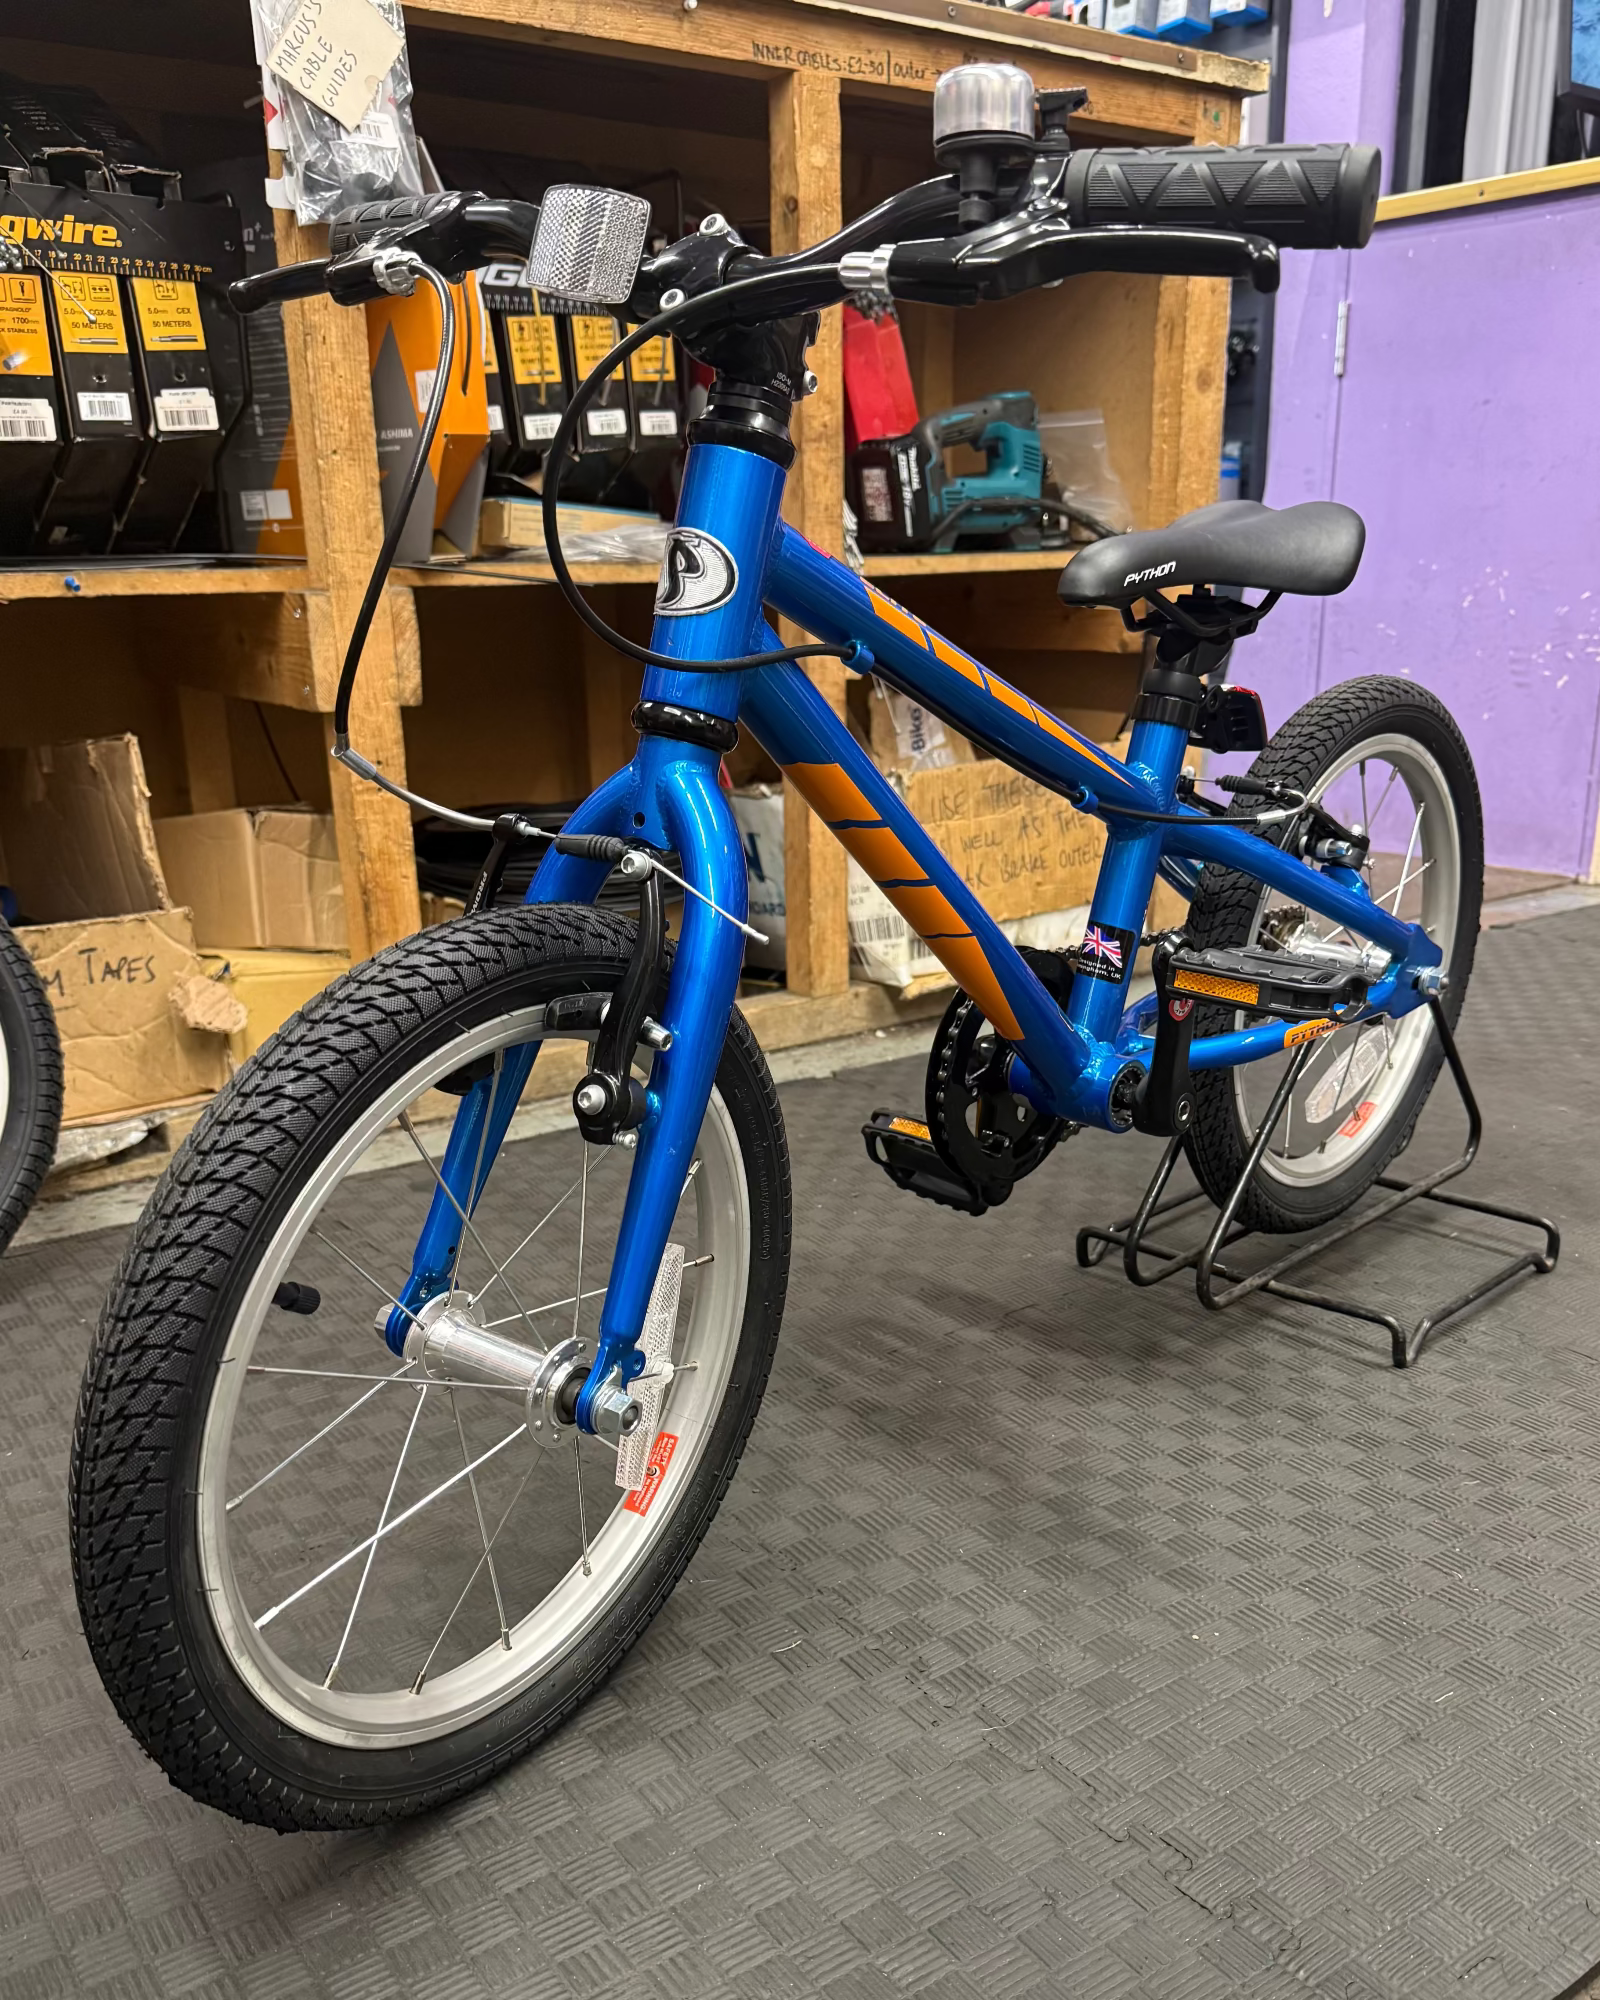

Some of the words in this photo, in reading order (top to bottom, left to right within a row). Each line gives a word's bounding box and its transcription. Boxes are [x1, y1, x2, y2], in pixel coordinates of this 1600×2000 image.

[300, 36, 333, 89] CABLE
[751, 40, 792, 65] INNER
[322, 49, 357, 107] GUIDES
[7, 327, 38, 335] STAINLESS
[71, 321, 80, 329] 50
[82, 322, 113, 331] METERS
[152, 320, 161, 328] 50
[162, 320, 192, 328] METERS
[381, 428, 414, 440] ASHIMA
[1123, 560, 1177, 587] PYTHON
[931, 789, 967, 825] USE
[982, 777, 1047, 812] THESE
[960, 831, 1002, 852] WELL
[1018, 815, 1042, 841] AS
[1000, 852, 1049, 883] BRAKE
[78, 947, 156, 984] TAPES
[1110, 971, 1121, 980] UK
[661, 1437, 675, 1466] SAFETY
